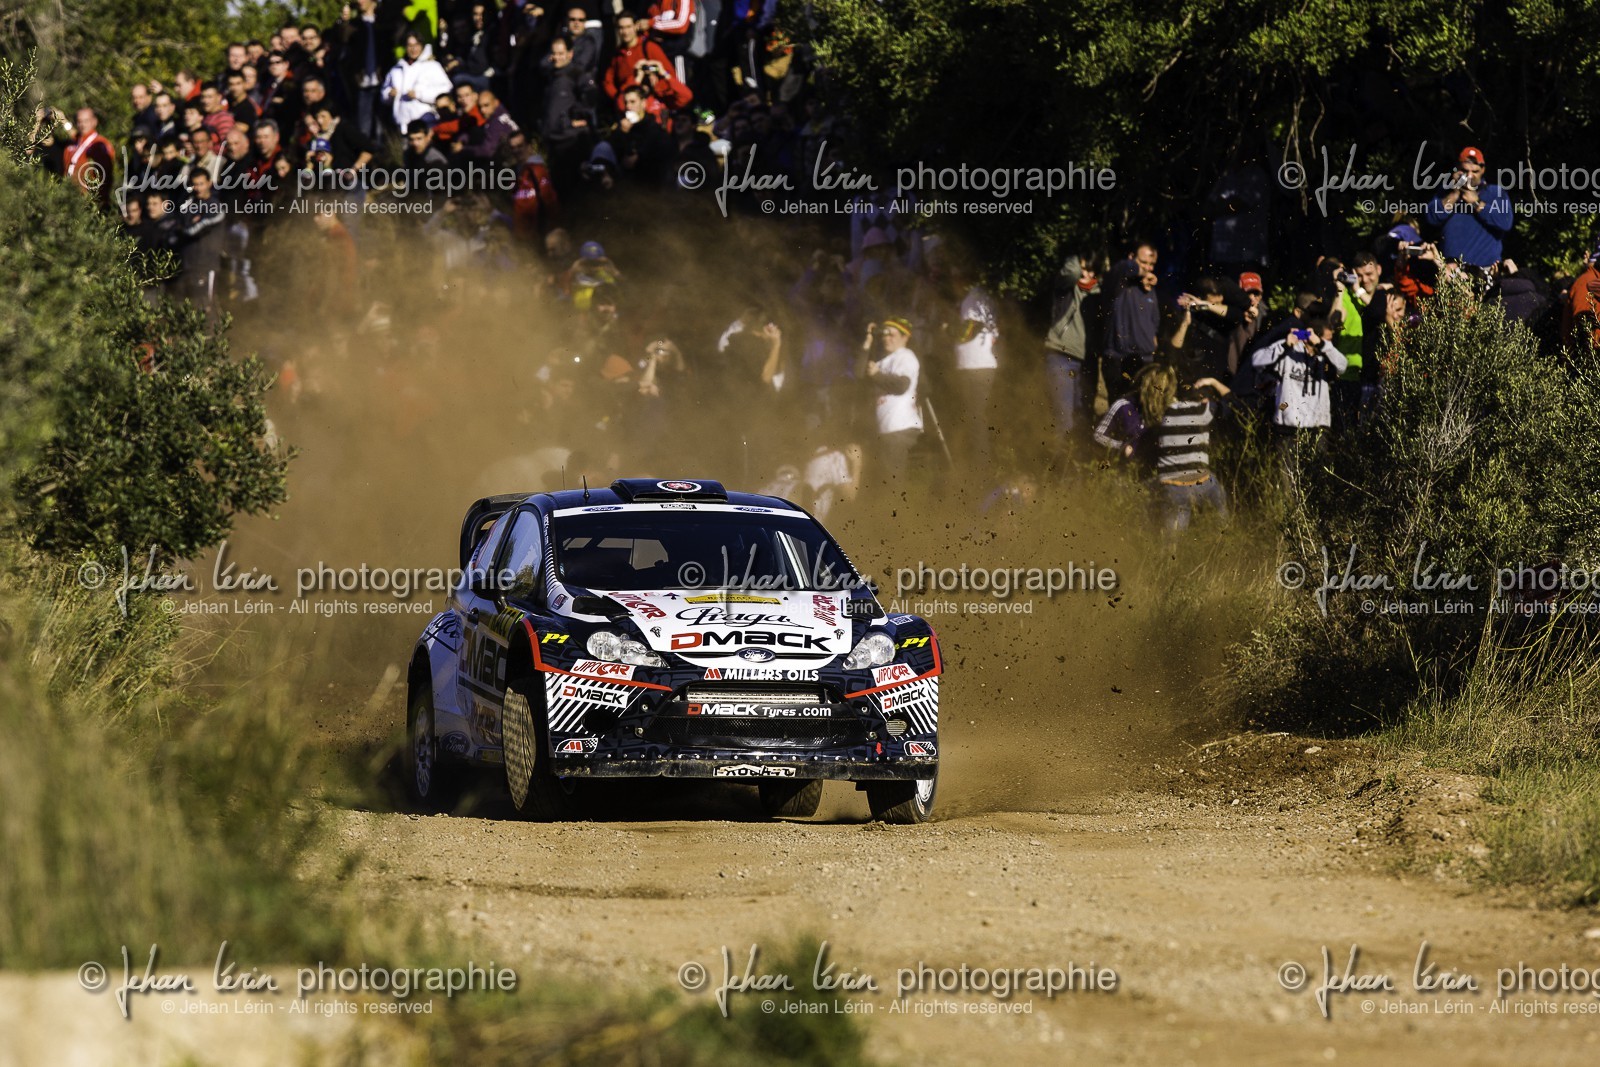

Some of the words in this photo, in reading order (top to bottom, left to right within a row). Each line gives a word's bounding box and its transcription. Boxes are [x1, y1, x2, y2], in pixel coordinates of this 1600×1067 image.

[676, 607, 814, 630] Praga
[541, 632, 570, 644] P1
[671, 630, 832, 653] DMACK
[902, 637, 930, 648] P1
[744, 650, 766, 659] Ford
[724, 669, 783, 681] MILLERS
[787, 670, 819, 682] OILS
[563, 685, 625, 705] DMACK
[884, 687, 927, 710] DMACK
